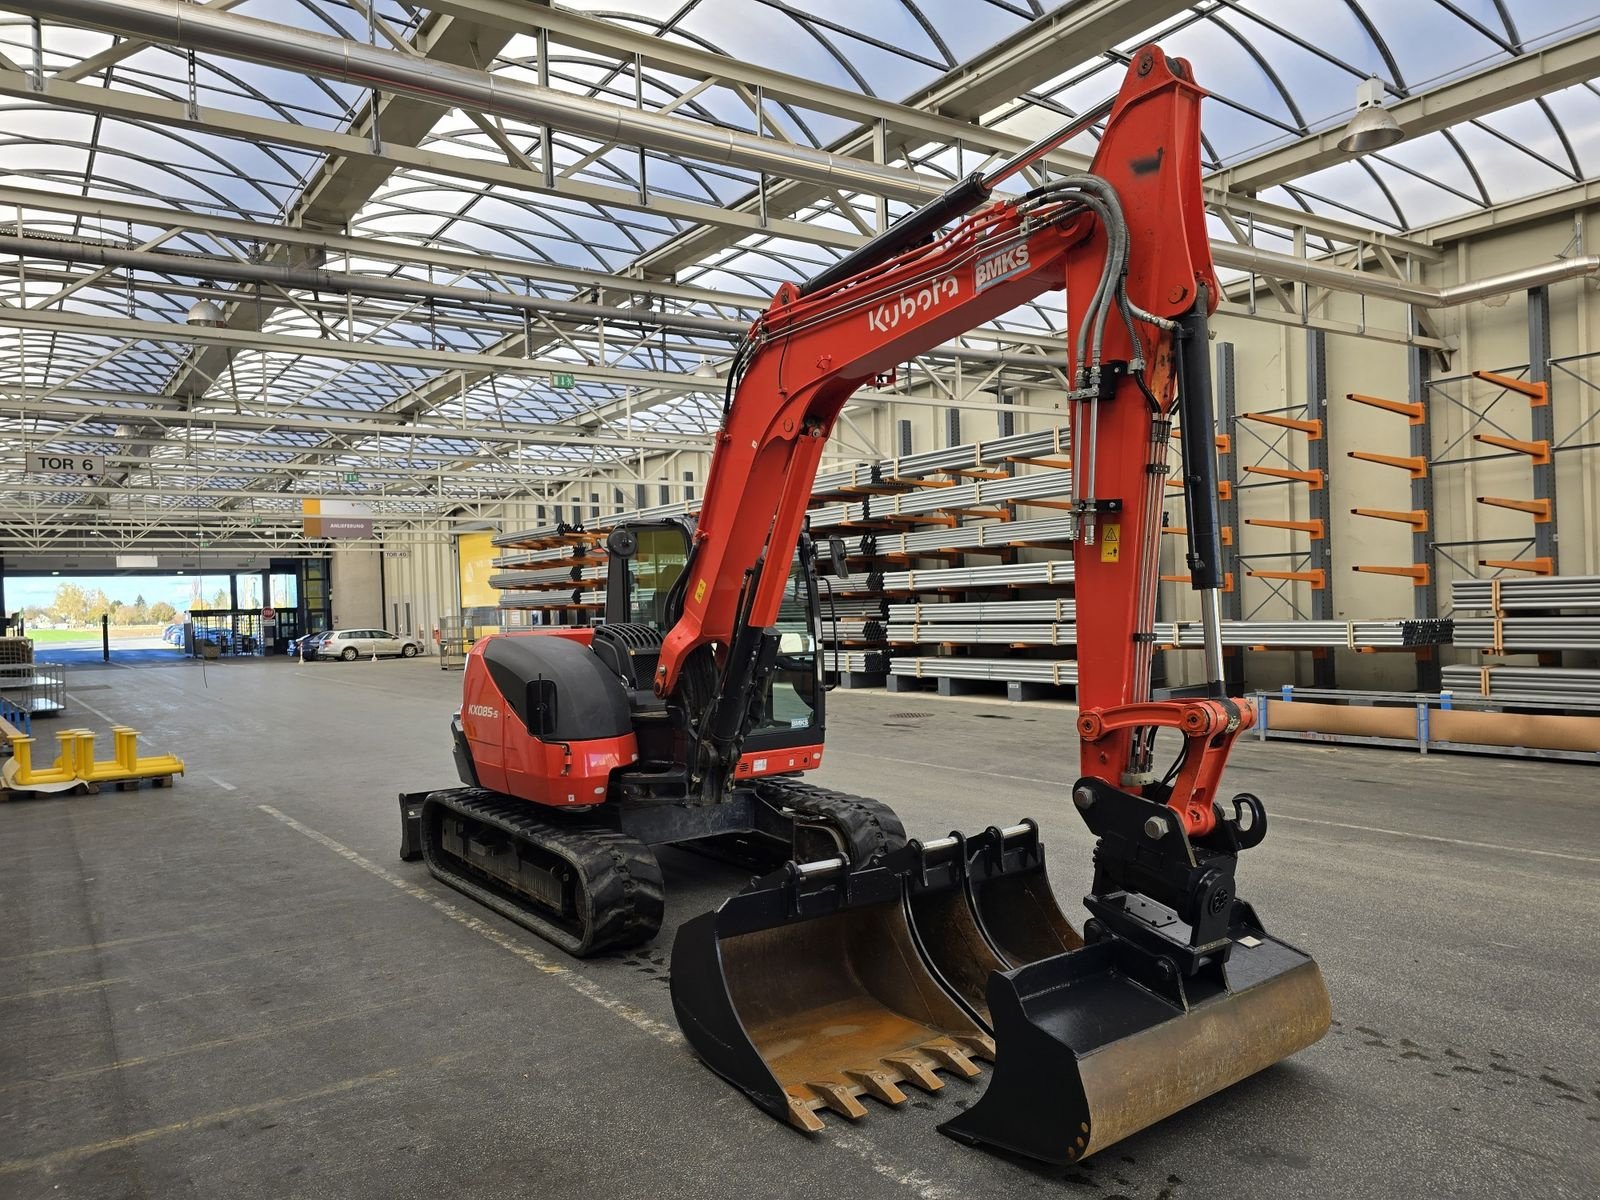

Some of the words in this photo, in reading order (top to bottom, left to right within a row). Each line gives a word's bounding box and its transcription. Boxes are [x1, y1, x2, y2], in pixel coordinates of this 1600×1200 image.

[976, 244, 1029, 288] BMKS
[868, 275, 959, 332] Kubota
[38, 457, 74, 470] TOR
[82, 459, 93, 471] 6
